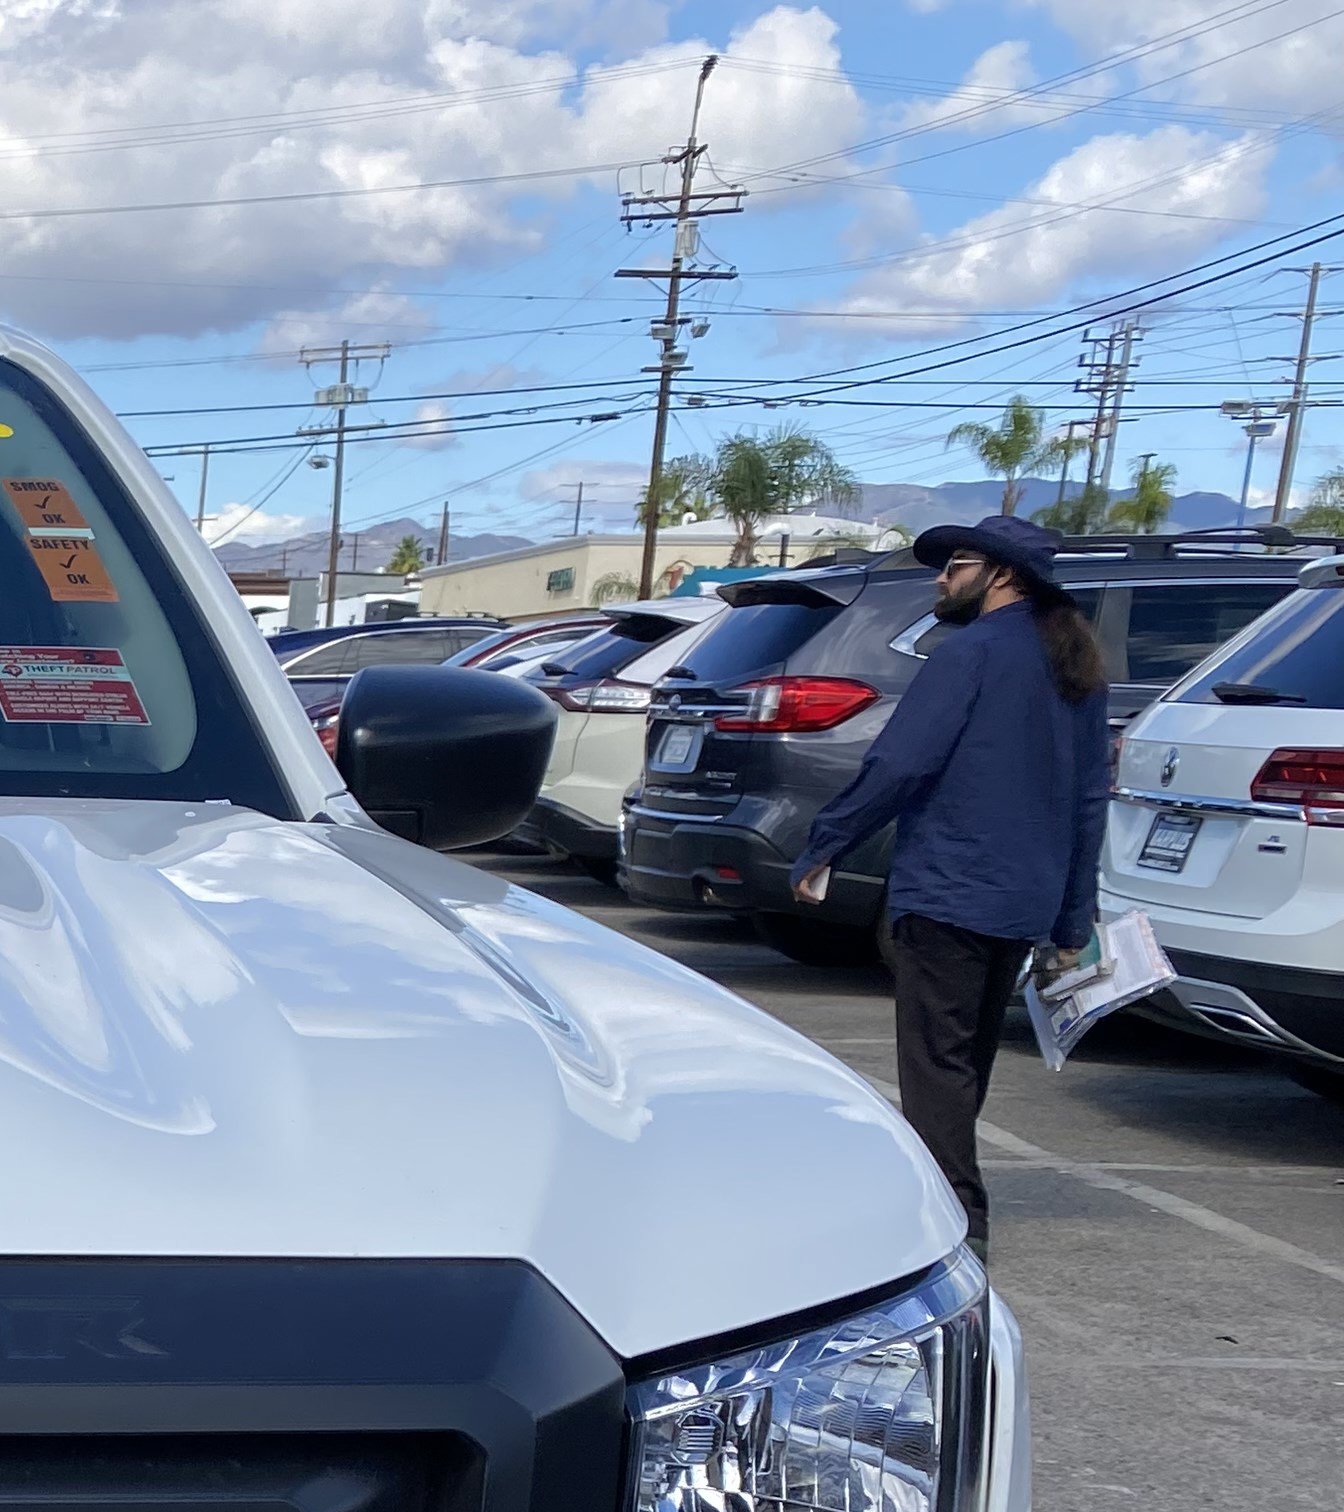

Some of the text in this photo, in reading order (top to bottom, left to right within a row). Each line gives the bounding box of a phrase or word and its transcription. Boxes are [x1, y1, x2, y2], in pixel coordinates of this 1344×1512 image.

[10, 481, 59, 492] SMOG
[42, 514, 65, 524] OK
[30, 539, 89, 550] SAFETY
[67, 574, 89, 584] OK
[24, 665, 64, 673] THEFT
[66, 666, 117, 675] PATROL
